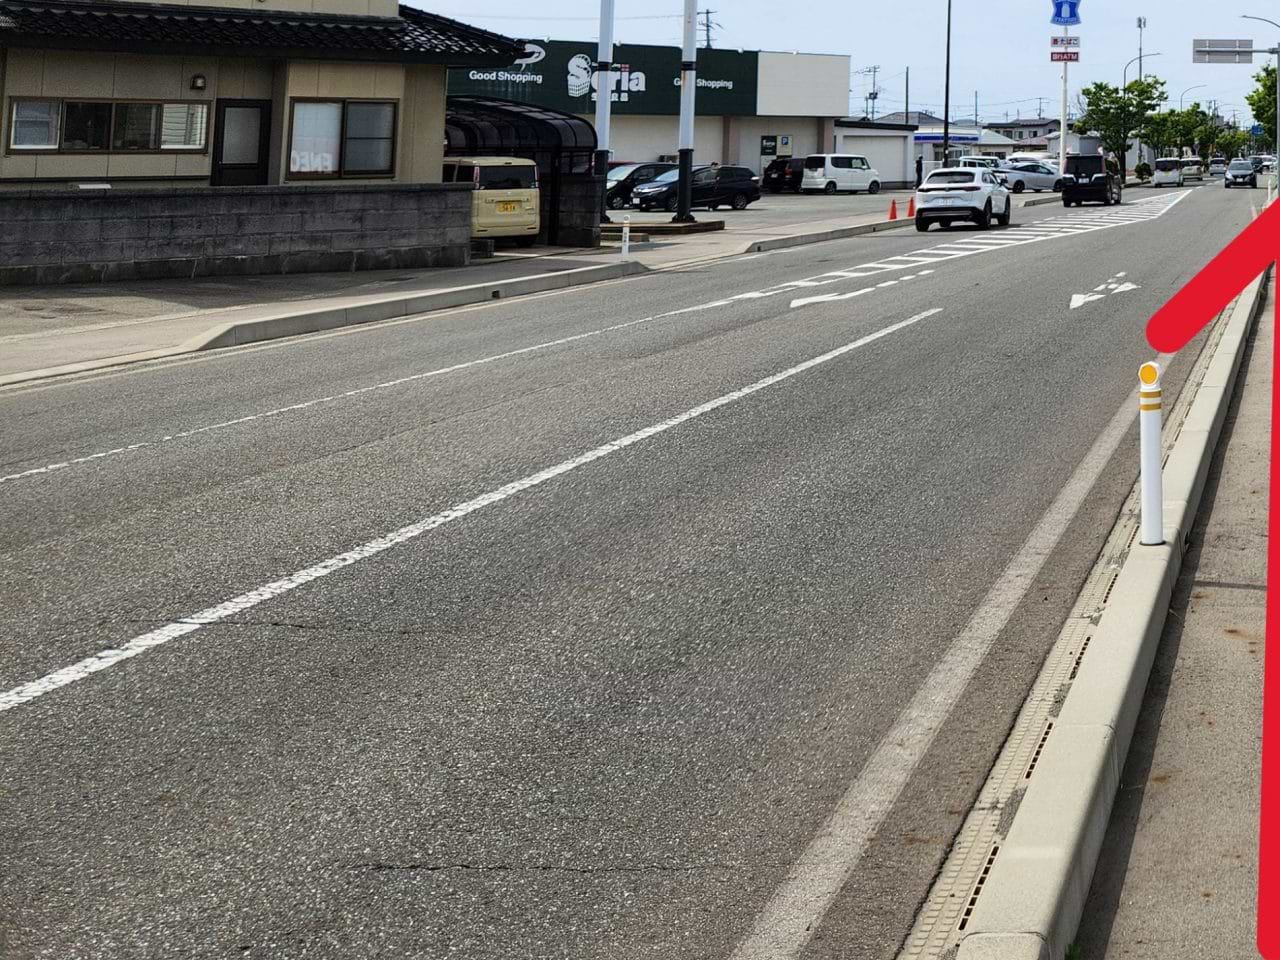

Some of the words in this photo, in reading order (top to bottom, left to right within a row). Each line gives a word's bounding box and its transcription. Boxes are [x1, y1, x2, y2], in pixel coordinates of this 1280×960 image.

[469, 71, 497, 81] Good
[498, 71, 543, 84] Shopping
[696, 78, 733, 90] Shopping
